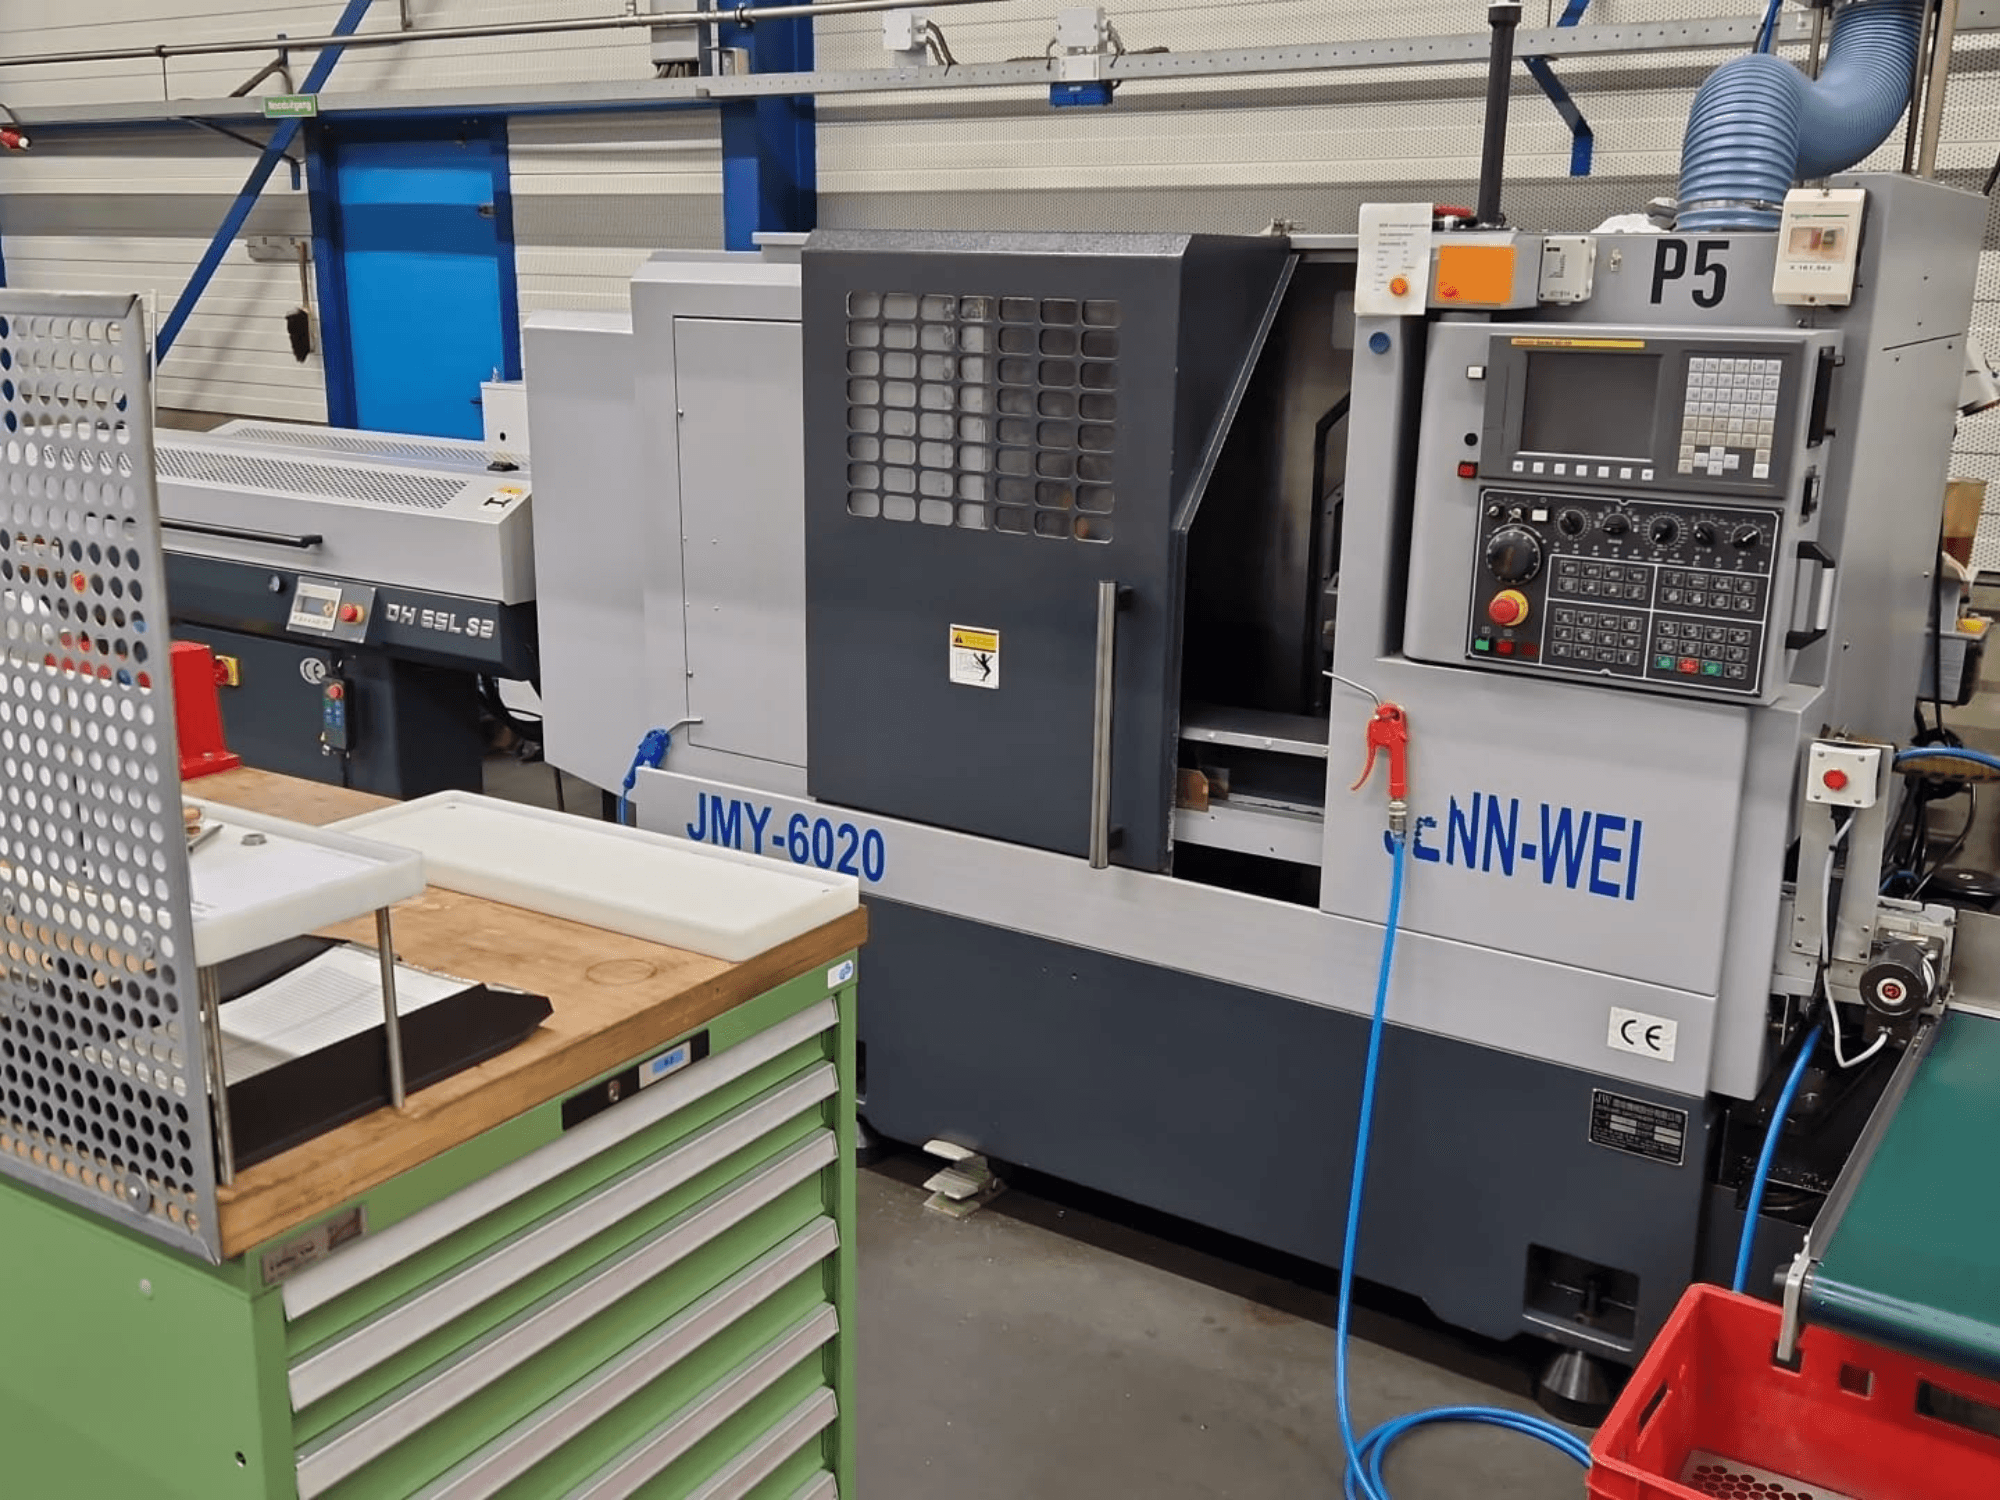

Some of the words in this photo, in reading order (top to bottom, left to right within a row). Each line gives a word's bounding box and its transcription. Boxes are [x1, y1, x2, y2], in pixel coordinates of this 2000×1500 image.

[1650, 239, 1730, 308] P5
[465, 617, 496, 640] S2
[686, 792, 885, 883] JMY-6020
[1620, 1019, 1663, 1051] CE
